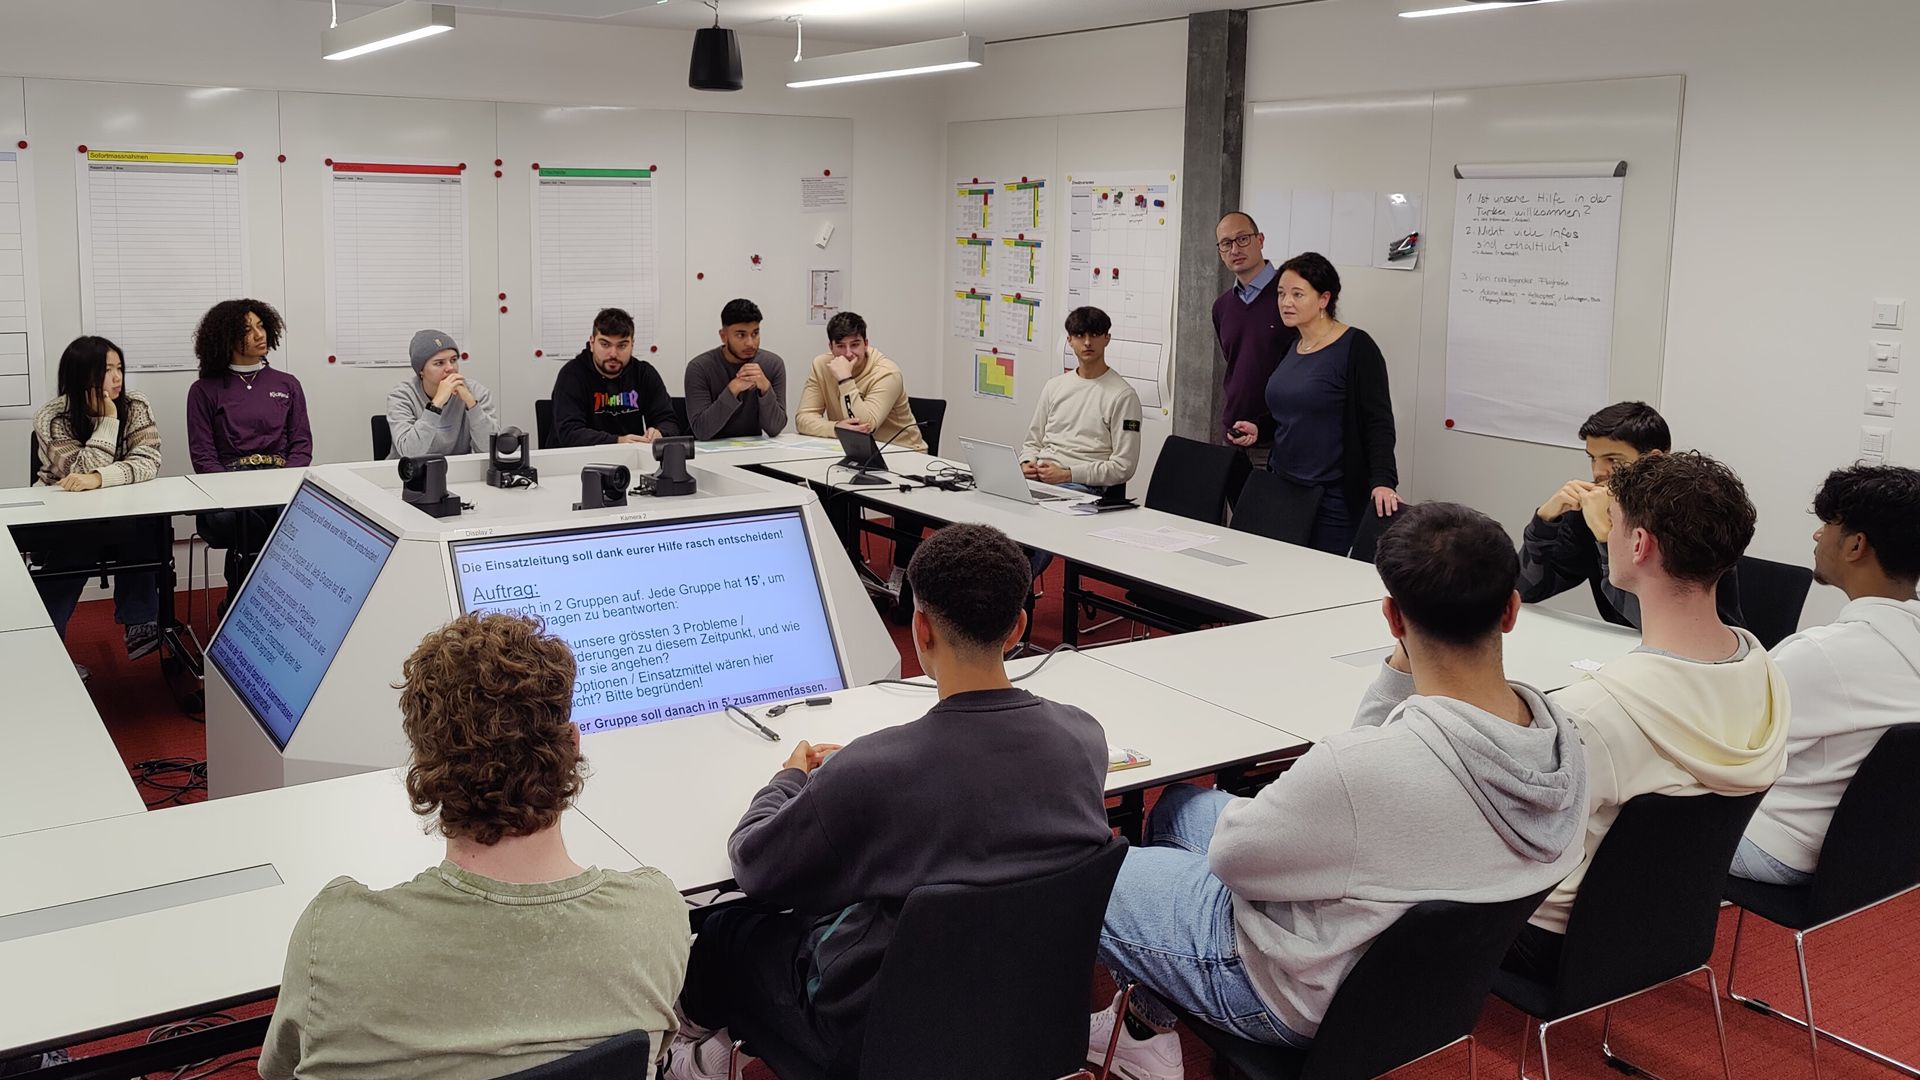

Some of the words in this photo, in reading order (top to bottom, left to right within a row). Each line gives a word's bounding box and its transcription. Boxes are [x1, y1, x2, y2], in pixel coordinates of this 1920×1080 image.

[90, 152, 149, 160] Sofortmassnahmen
[1494, 195, 1530, 204] unsere
[1536, 192, 1565, 205] Hilfe
[1575, 194, 1585, 203] in
[1590, 193, 1612, 204] der
[465, 529, 487, 537] Display
[462, 562, 482, 574] Die
[485, 554, 569, 572] Einsatzleitung
[572, 550, 593, 562] soll
[596, 547, 624, 559] dank
[626, 545, 655, 557] eurer
[658, 540, 683, 553] Hilfe
[686, 537, 716, 549] rasch
[718, 529, 784, 546] entscheiden!
[473, 583, 540, 603] Auftrag:
[539, 601, 551, 613] in
[554, 599, 563, 611] 2
[566, 594, 619, 610] Gruppen
[622, 589, 645, 603] auf.
[648, 586, 676, 600] Jede
[679, 583, 721, 597] Gruppe
[724, 577, 743, 590] hat
[767, 573, 785, 584] um
[545, 613, 582, 627] ragen
[584, 611, 600, 621] zu
[602, 600, 679, 619] beantworten:
[573, 634, 616, 650] unsere
[619, 626, 670, 645] grössten
[673, 623, 681, 635] 3
[683, 617, 738, 634] Probleme
[638, 643, 652, 654] zu
[655, 636, 698, 651] diesem
[700, 628, 756, 645] Zeitpunkt,
[758, 623, 780, 636] und
[781, 620, 801, 633] wie
[573, 675, 632, 695] Optionen
[638, 661, 713, 684] Einsatzmittel
[715, 657, 751, 672] wären
[752, 652, 774, 665] hier
[577, 665, 586, 676] ir
[589, 662, 608, 675] sie
[611, 652, 670, 672] angehen?
[571, 692, 602, 708] acht?
[605, 688, 634, 703] Bitte
[636, 676, 704, 698] begründen!
[579, 721, 591, 732] er
[594, 713, 638, 730] Gruppe
[641, 708, 662, 722] soll
[664, 702, 706, 718] danach
[707, 699, 719, 711] in
[733, 683, 828, 706] zusammenfassen.
